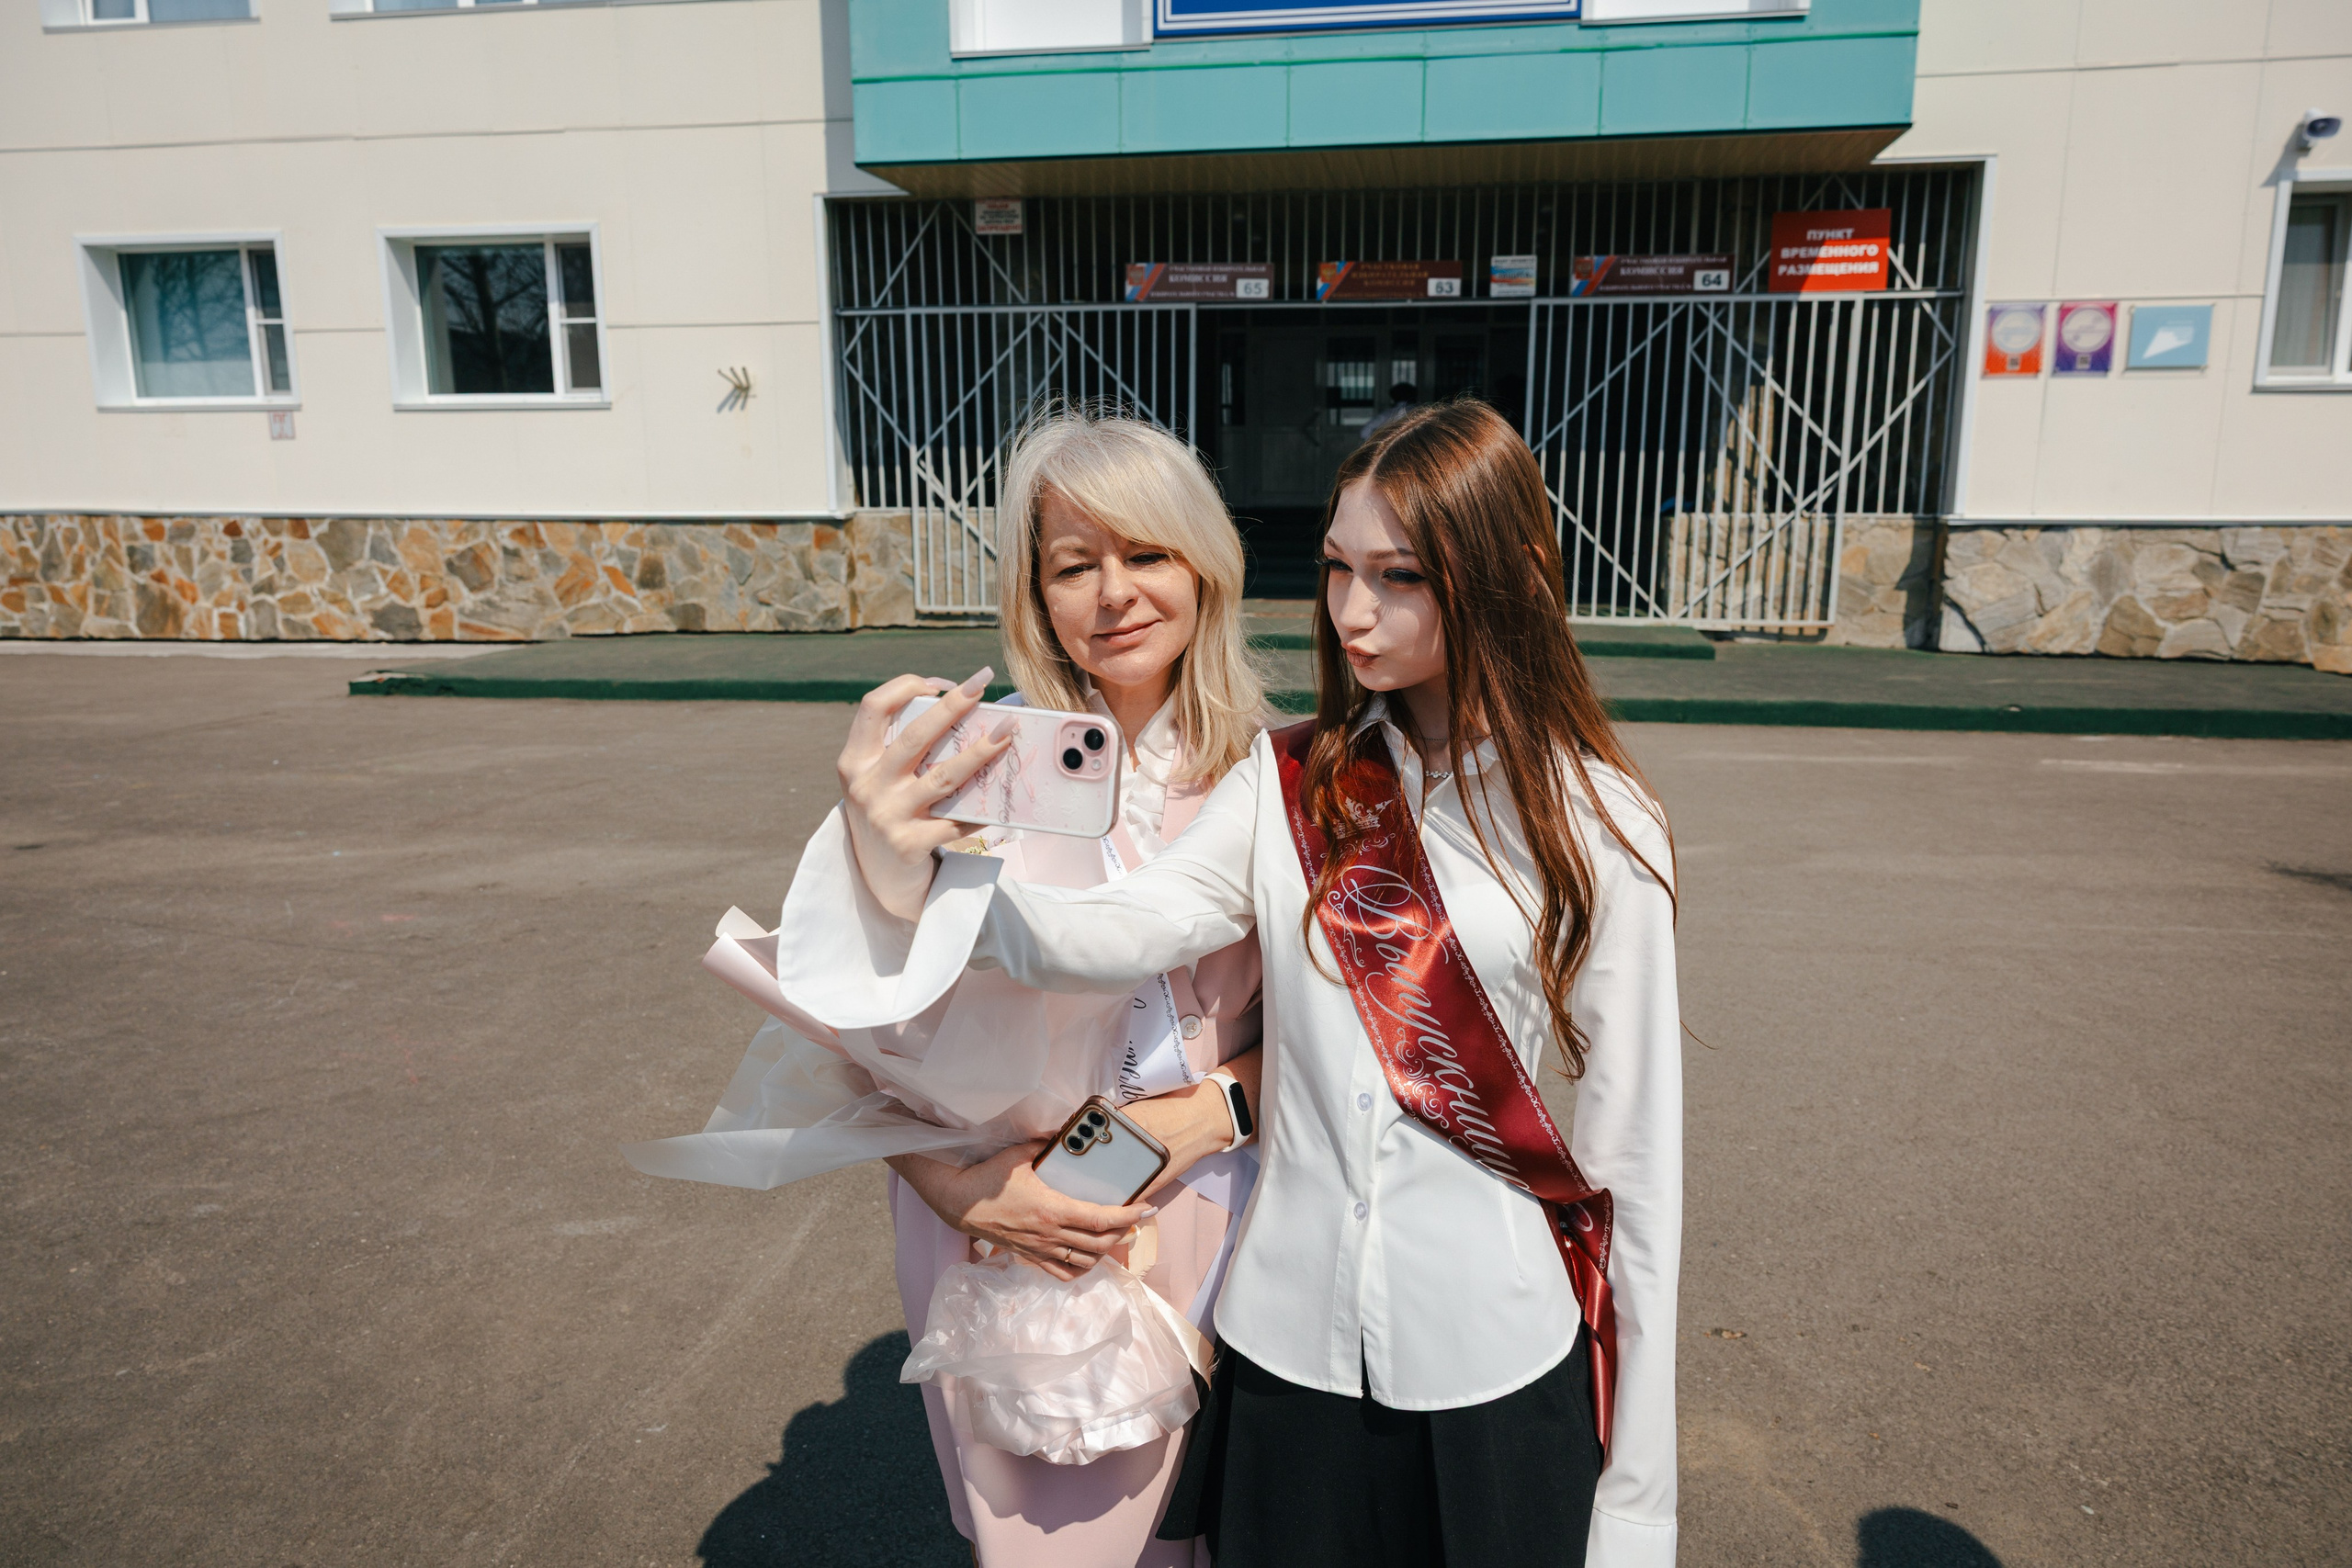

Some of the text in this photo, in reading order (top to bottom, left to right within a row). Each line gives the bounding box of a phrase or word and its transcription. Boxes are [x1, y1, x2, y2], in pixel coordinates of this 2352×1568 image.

[1805, 228, 1855, 241] ПУНКТ
[1780, 243, 1880, 260] ВРЕМЕННОГО
[1777, 262, 1880, 276] РАЗМЕЩЕНИЯ
[1702, 274, 1722, 287] 64
[1243, 282, 1262, 295] 65
[1435, 281, 1454, 294] 63
